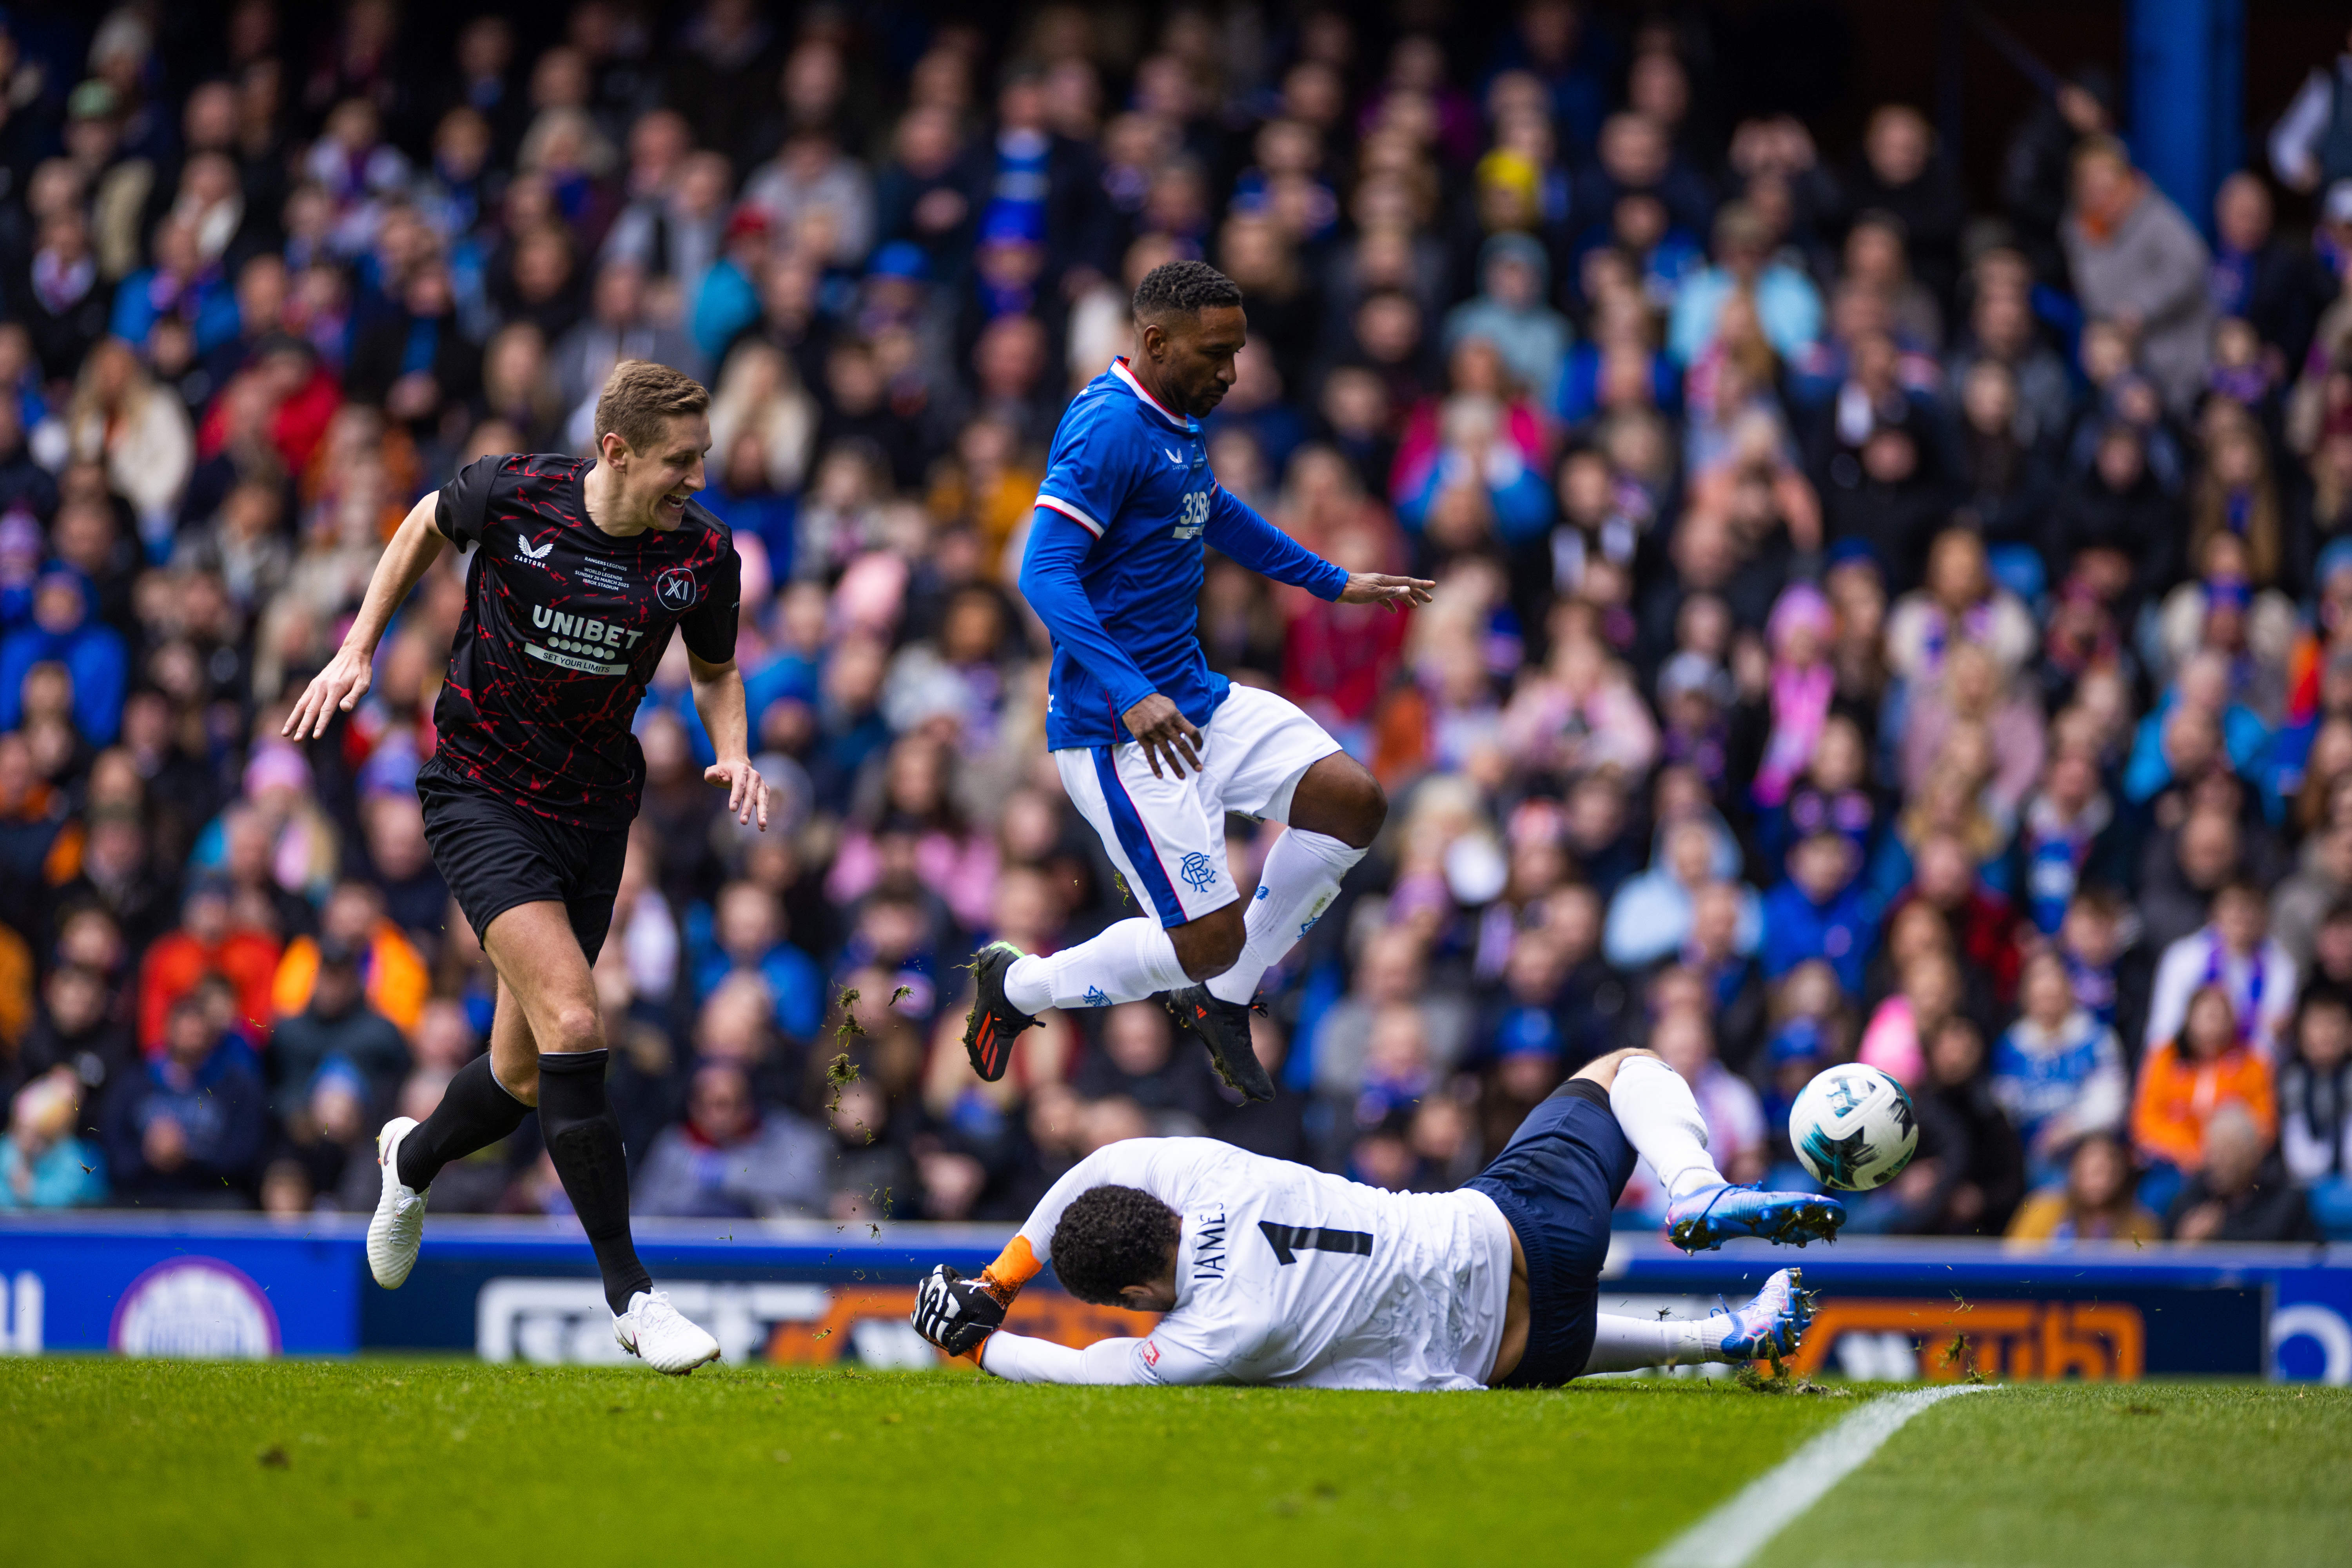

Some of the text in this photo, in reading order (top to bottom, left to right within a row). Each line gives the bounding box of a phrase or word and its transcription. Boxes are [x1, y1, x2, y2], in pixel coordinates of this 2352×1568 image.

[514, 555, 546, 568] CASTORE
[584, 557, 627, 571] RANGERS LEGENDS
[575, 570, 594, 579] SUNDAY
[602, 572, 622, 581] LEGENDS
[598, 582, 619, 591] STADIUM
[665, 577, 689, 600] XI
[532, 604, 644, 649] UNIBET
[543, 652, 610, 673] SET YOUR LIMITS
[1258, 1220, 1374, 1266] 1
